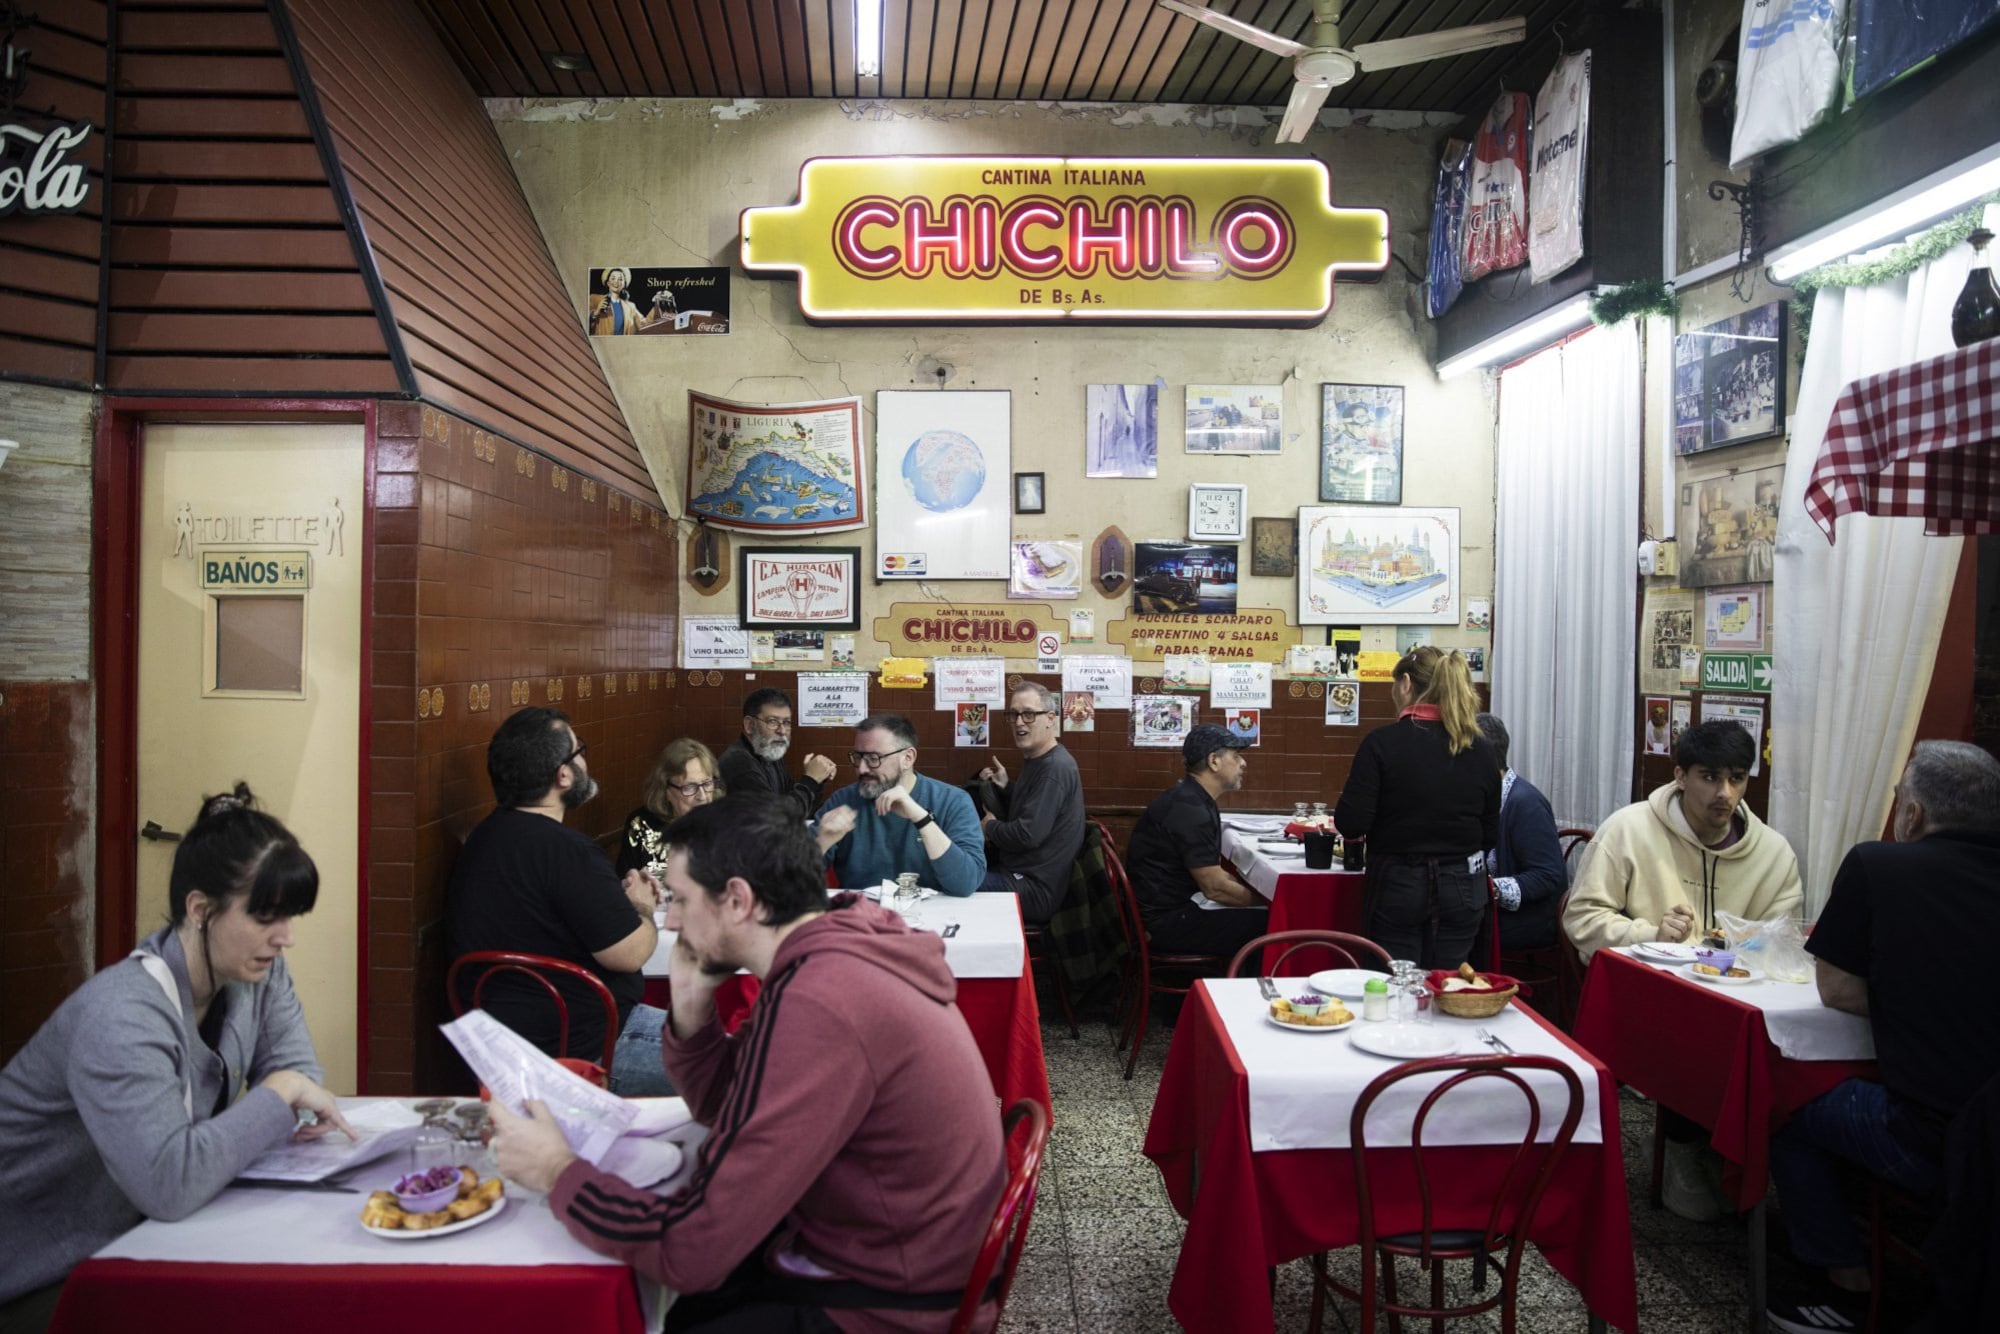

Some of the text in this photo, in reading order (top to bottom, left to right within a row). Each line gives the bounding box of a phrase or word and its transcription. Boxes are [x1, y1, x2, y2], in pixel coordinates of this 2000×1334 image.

[981, 169, 1147, 186] CANTINA ITALIANA
[834, 196, 1294, 280] CHICHILO
[647, 276, 716, 289] Shop refreshed
[1019, 288, 1106, 305] DE Bs. As.
[747, 416, 793, 428] LIGURIA
[196, 516, 319, 542] TOILETTE
[206, 556, 279, 583] BAÑOS
[795, 578, 808, 591] H
[936, 608, 1005, 617] CANTINA ITALIANA
[1205, 615, 1273, 625] SCARPARO
[903, 618, 1037, 644] CHICHILO
[1131, 629, 1209, 640] SORRENTINO
[1231, 631, 1279, 642] SALSAS
[951, 645, 962, 653] DE
[1706, 660, 1747, 684] SALIDA
